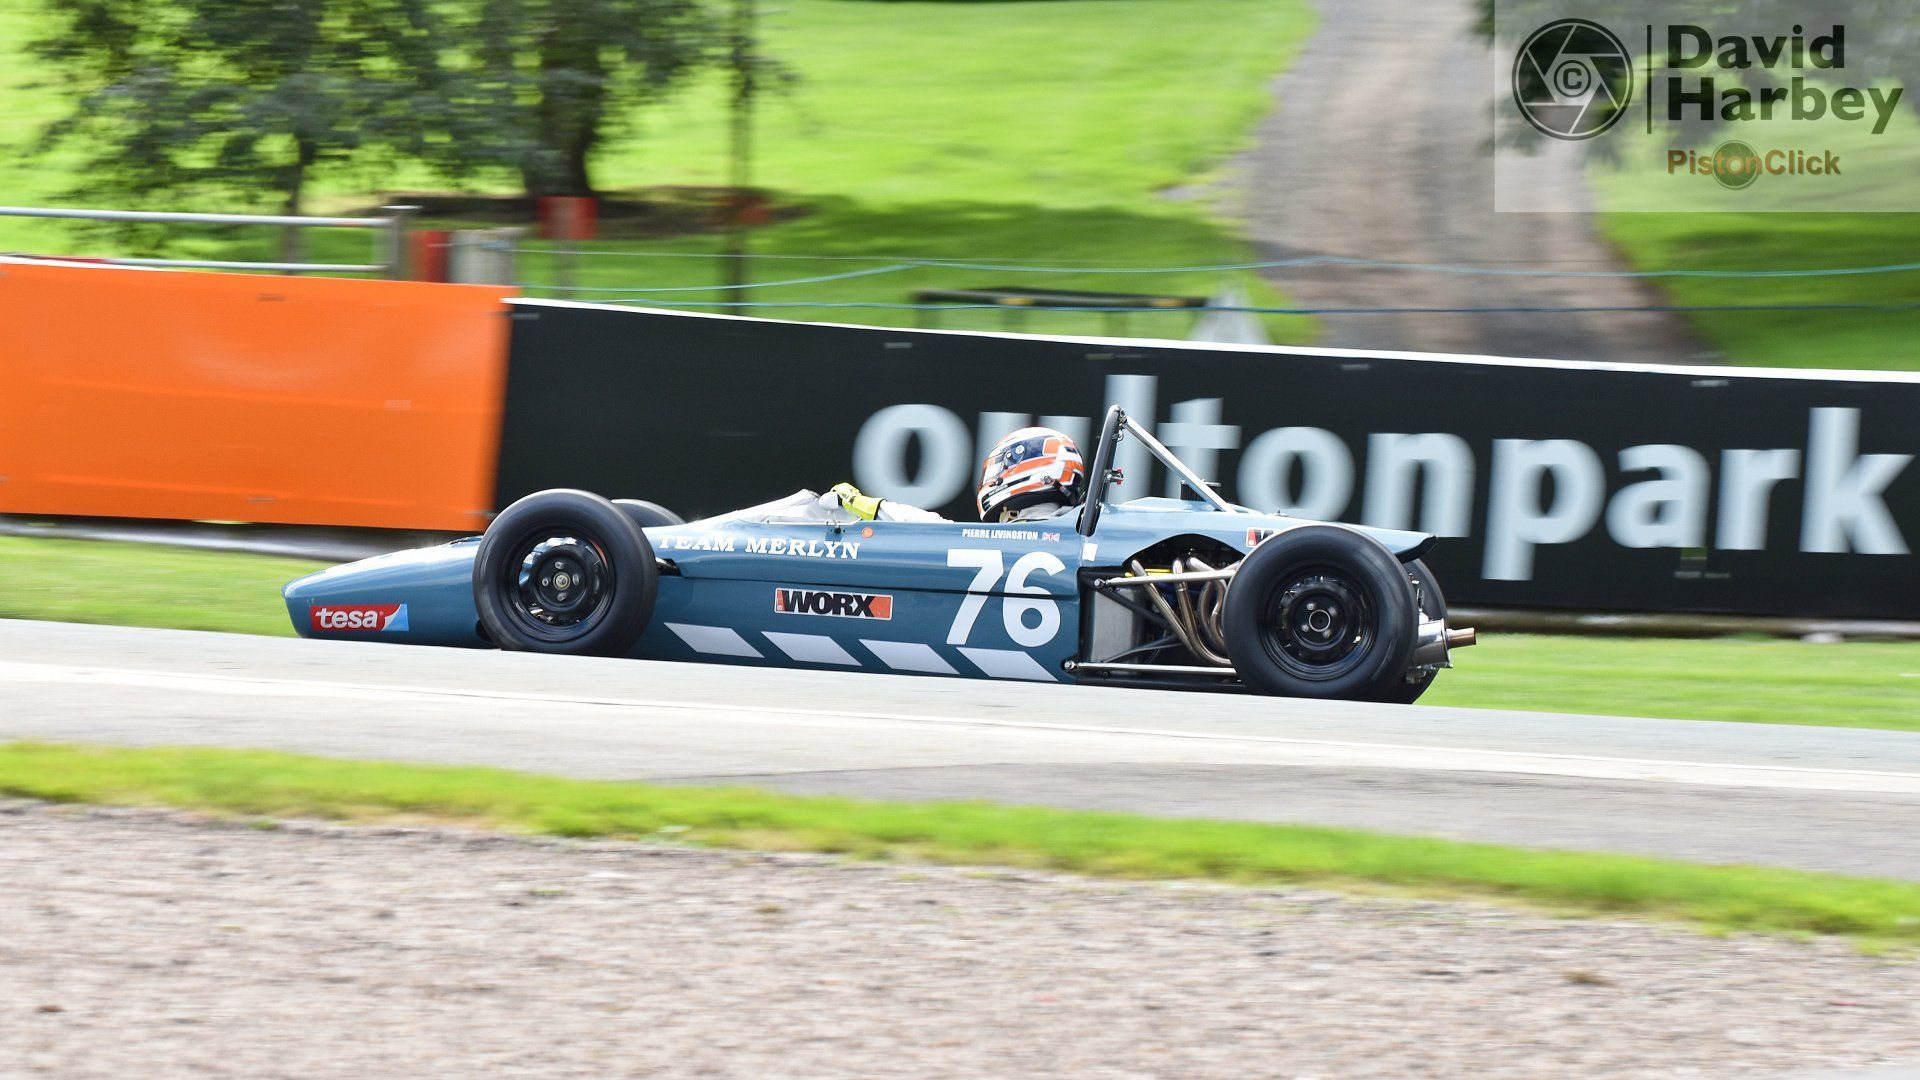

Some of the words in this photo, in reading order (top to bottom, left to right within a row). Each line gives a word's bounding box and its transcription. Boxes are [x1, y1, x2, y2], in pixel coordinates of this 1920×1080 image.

[962, 528, 990, 539] PIERRE
[658, 535, 736, 552] TEAM
[745, 537, 861, 560] MERLYN
[782, 589, 876, 617] WORX
[946, 548, 1066, 648] 76
[315, 607, 379, 629] tesa
